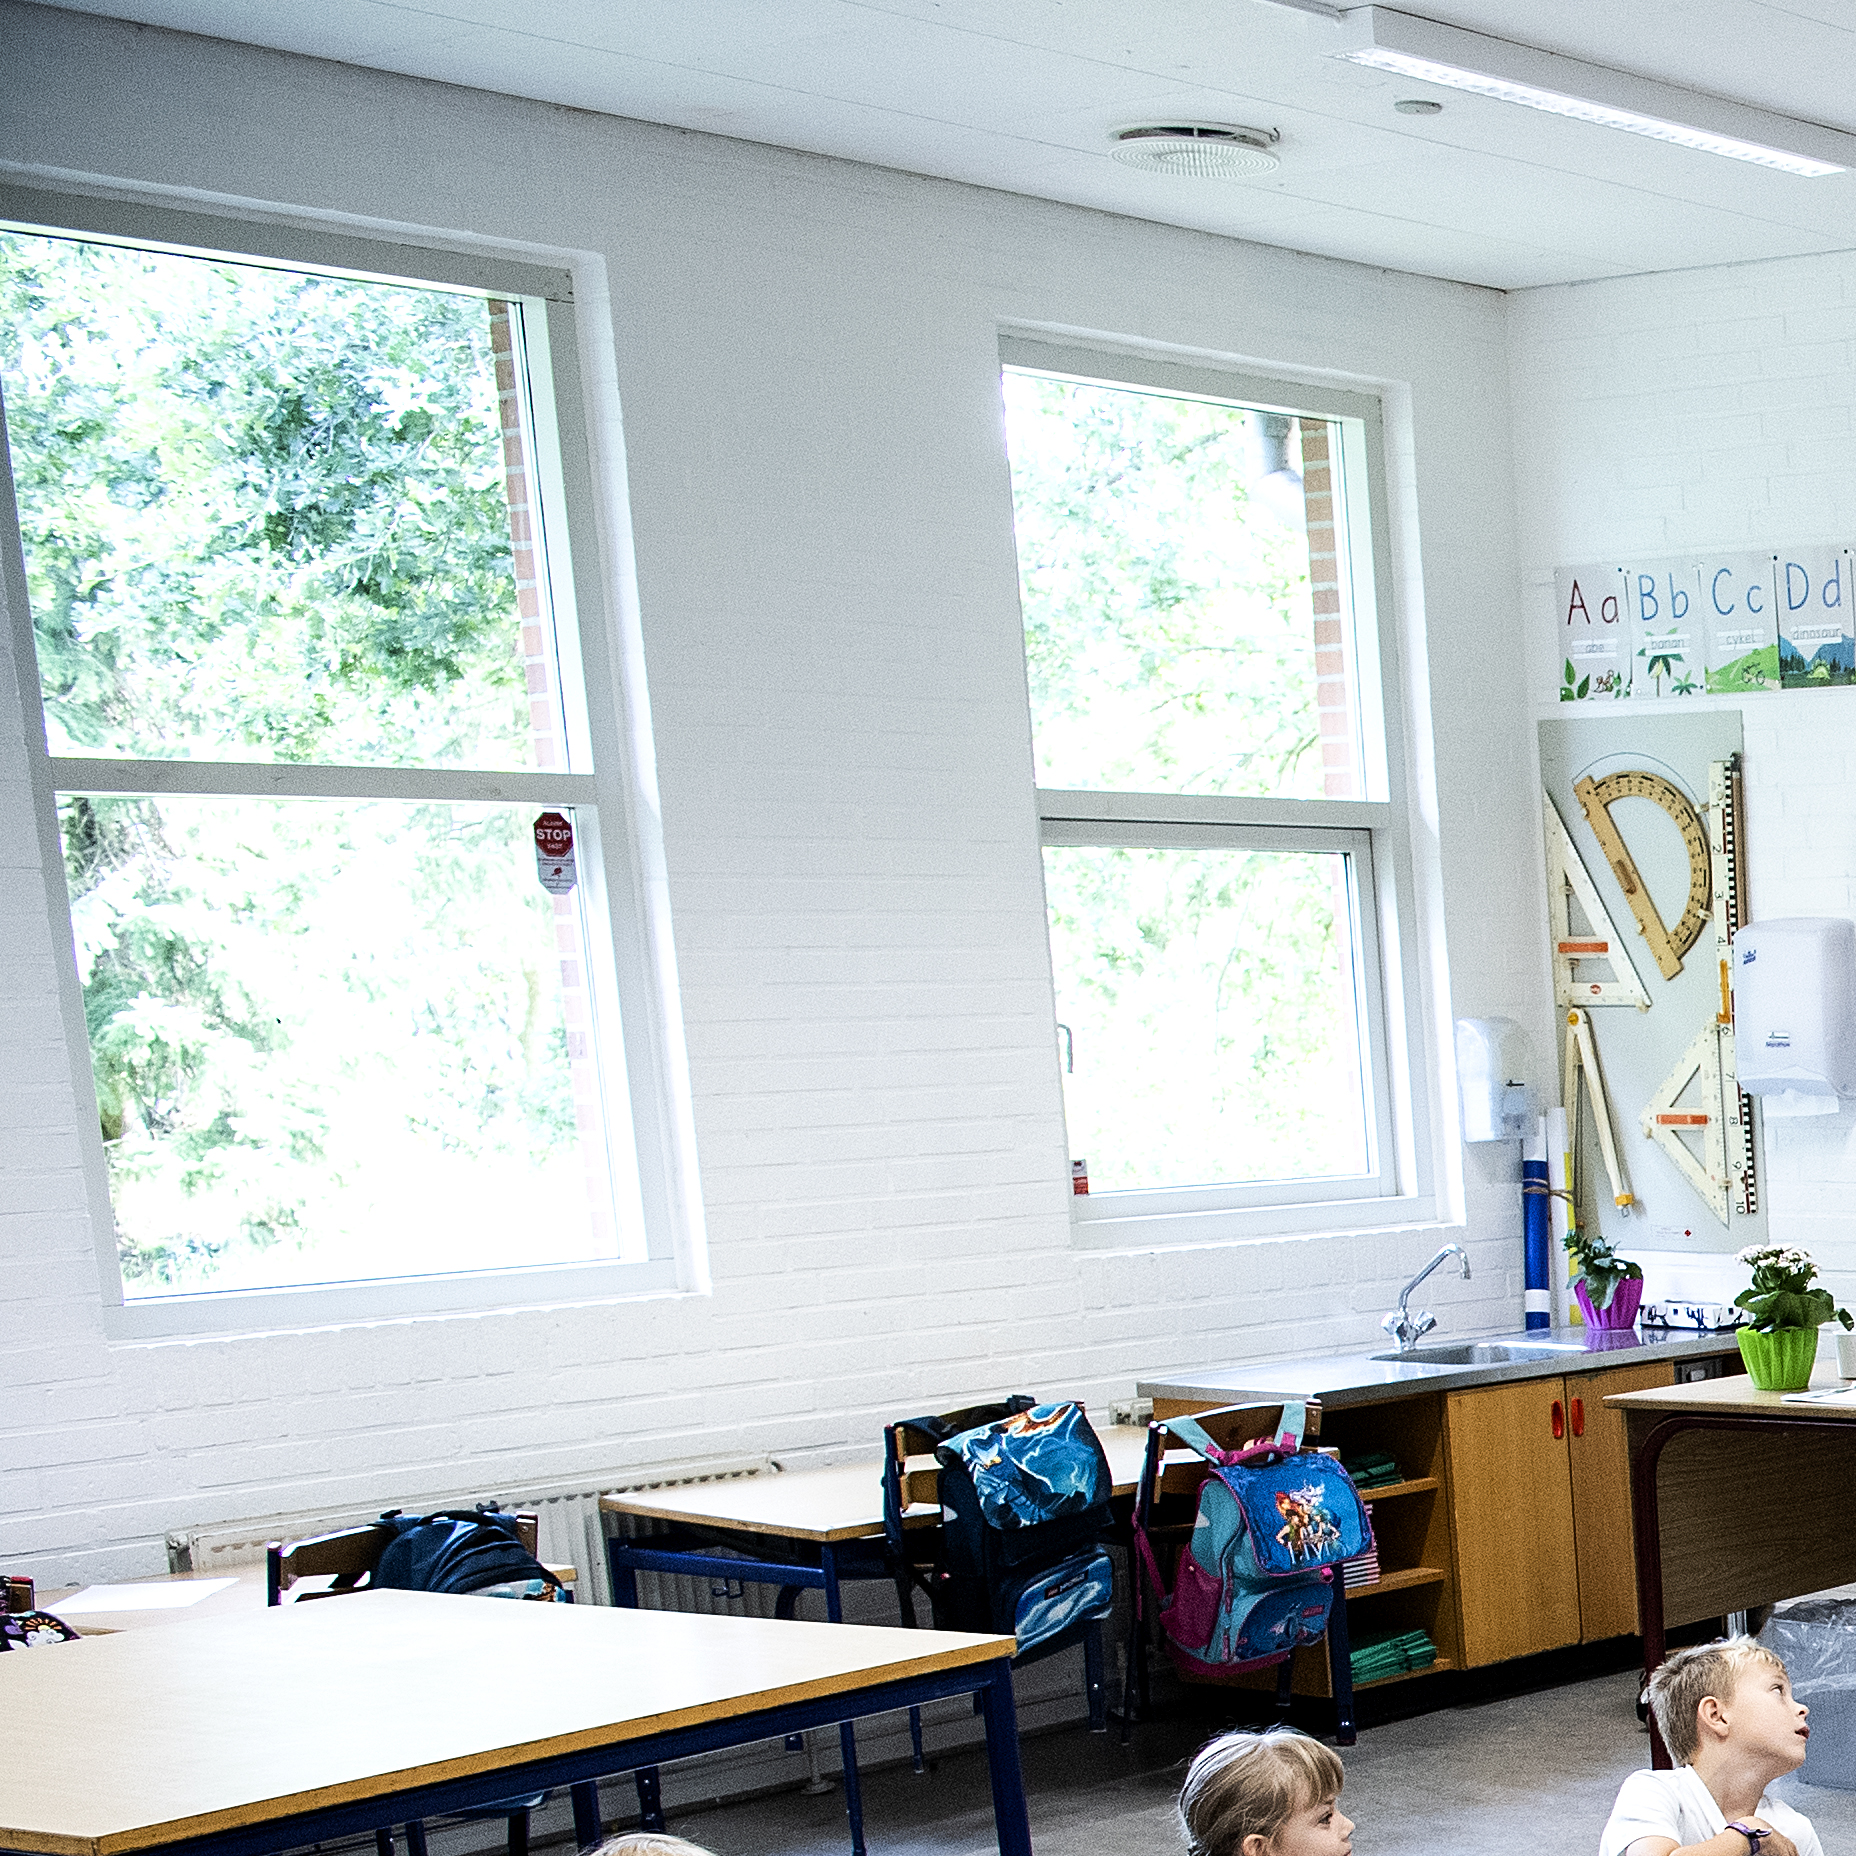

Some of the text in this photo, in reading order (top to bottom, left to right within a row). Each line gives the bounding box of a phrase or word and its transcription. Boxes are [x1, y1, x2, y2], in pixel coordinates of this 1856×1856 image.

[1725, 630, 1756, 650] cykel
[536, 828, 572, 840] STOP
[1712, 845, 1722, 854] 2
[1714, 890, 1724, 900] 3
[1718, 935, 1726, 946] 4
[1722, 1026, 1732, 1036] 6
[1725, 1072, 1735, 1080] 7
[1728, 1116, 1738, 1126] 8
[1732, 1160, 1742, 1170] 9
[1735, 1200, 1746, 1214] 10
